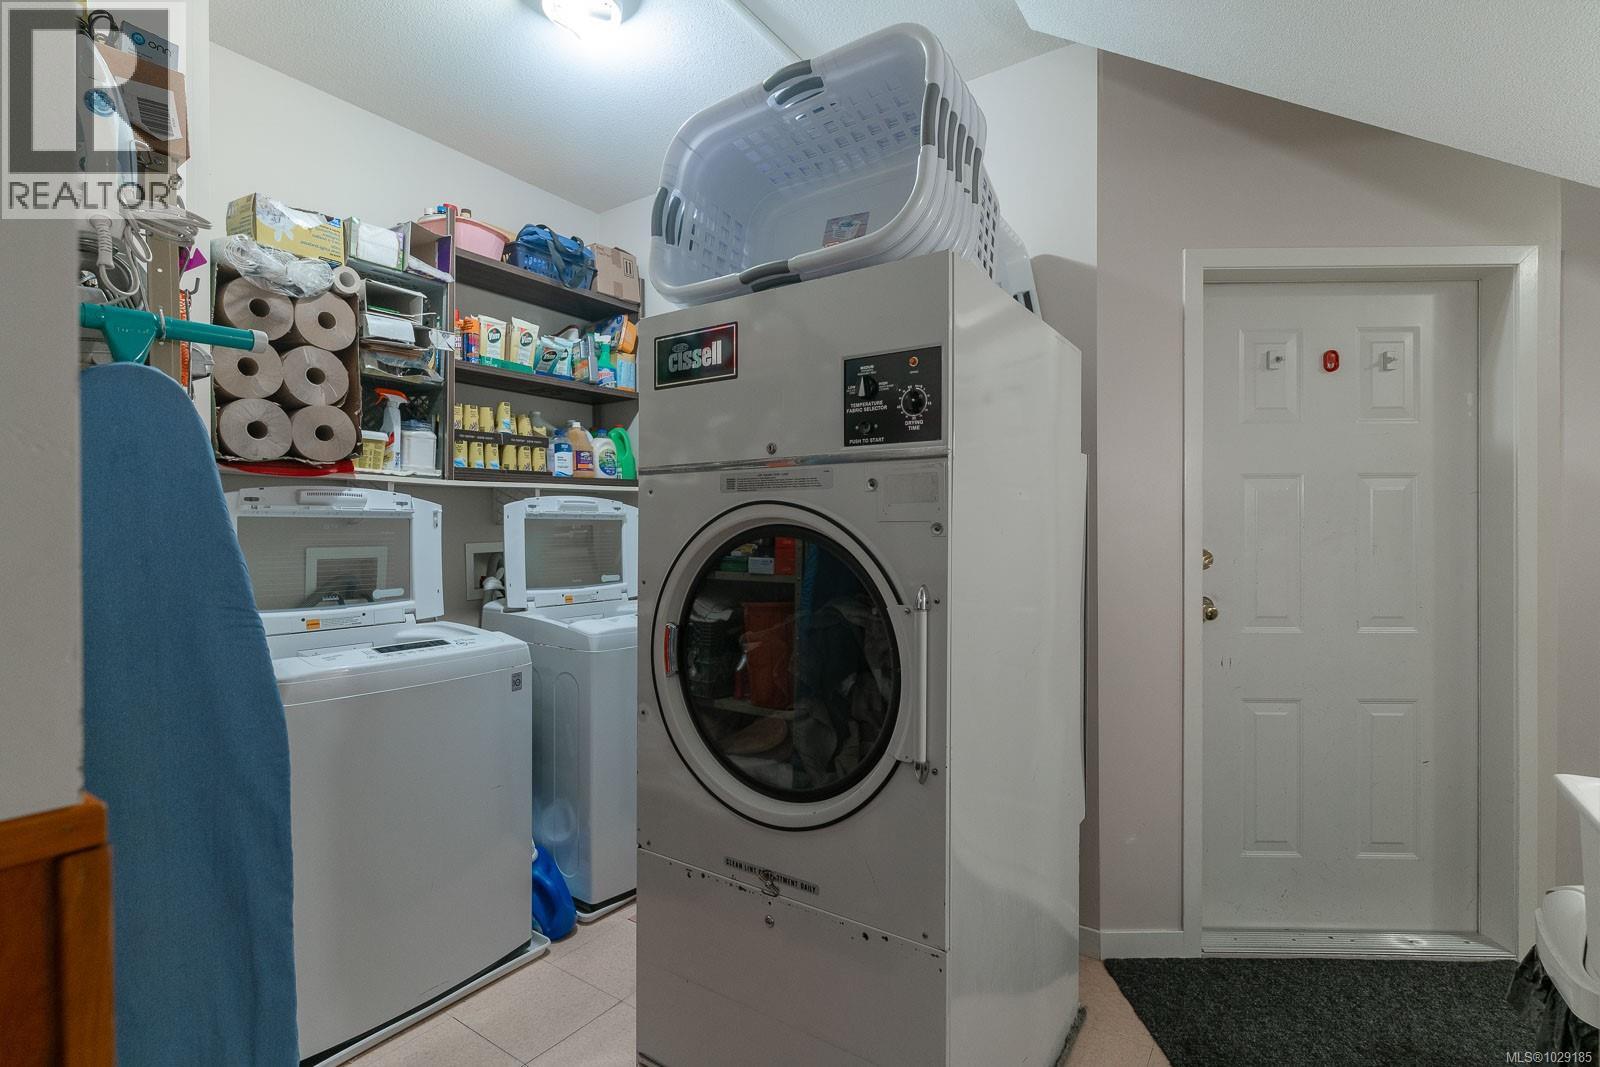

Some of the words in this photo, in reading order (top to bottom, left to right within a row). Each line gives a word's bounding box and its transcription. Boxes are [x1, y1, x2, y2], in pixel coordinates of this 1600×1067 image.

[850, 400, 883, 408] TEMPERATURE
[726, 858, 743, 869] CLEAN
[800, 882, 816, 895] DAILY
